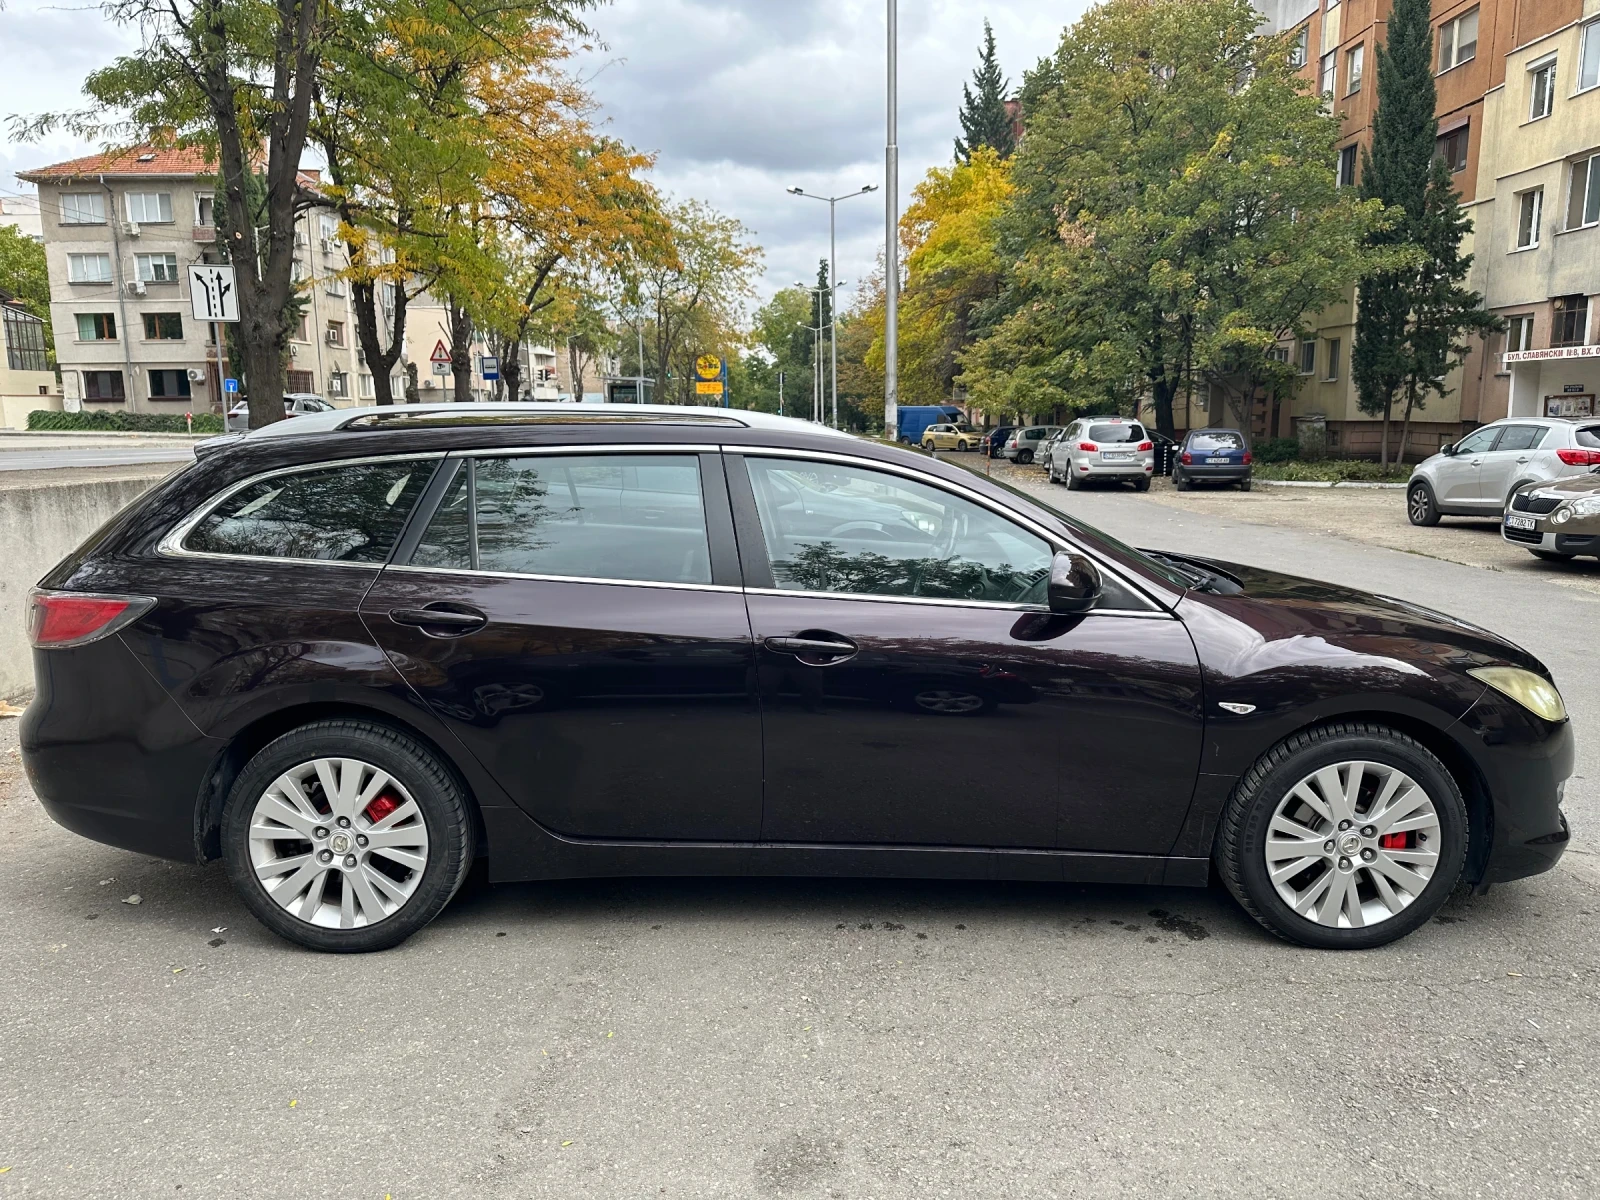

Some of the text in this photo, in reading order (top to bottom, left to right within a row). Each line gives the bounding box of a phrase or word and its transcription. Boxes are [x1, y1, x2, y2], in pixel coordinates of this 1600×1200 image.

[1507, 353, 1522, 361] БУЛ.
[1522, 349, 1563, 360] СЛАВЯНСКИ
[1581, 347, 1594, 356] ВХ.
